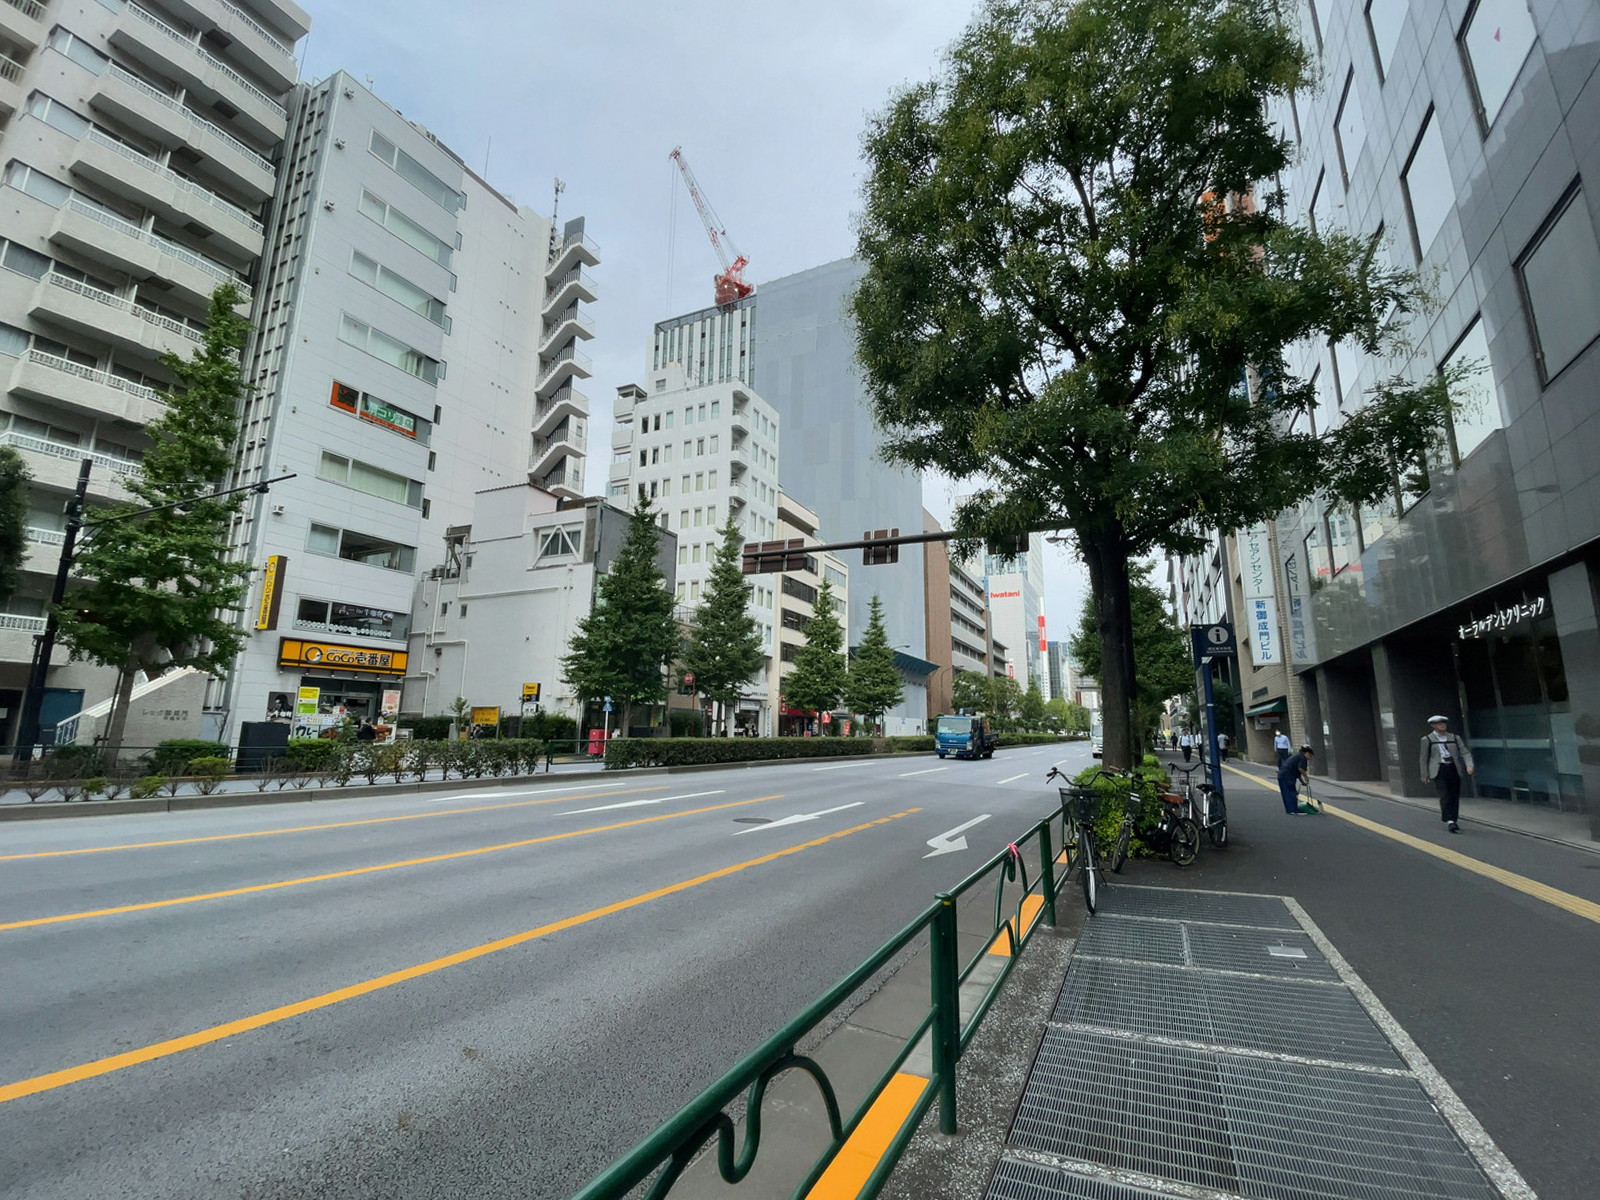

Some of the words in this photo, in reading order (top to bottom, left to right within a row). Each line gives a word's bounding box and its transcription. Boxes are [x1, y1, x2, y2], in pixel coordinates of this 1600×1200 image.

[1248, 534, 1263, 594] アセアンセンター
[1255, 600, 1273, 660] 新御成門ビル
[1458, 597, 1545, 640] オーラルデントクリニック
[327, 651, 390, 666] CoCo壱番屋
[296, 726, 318, 736] カレー
